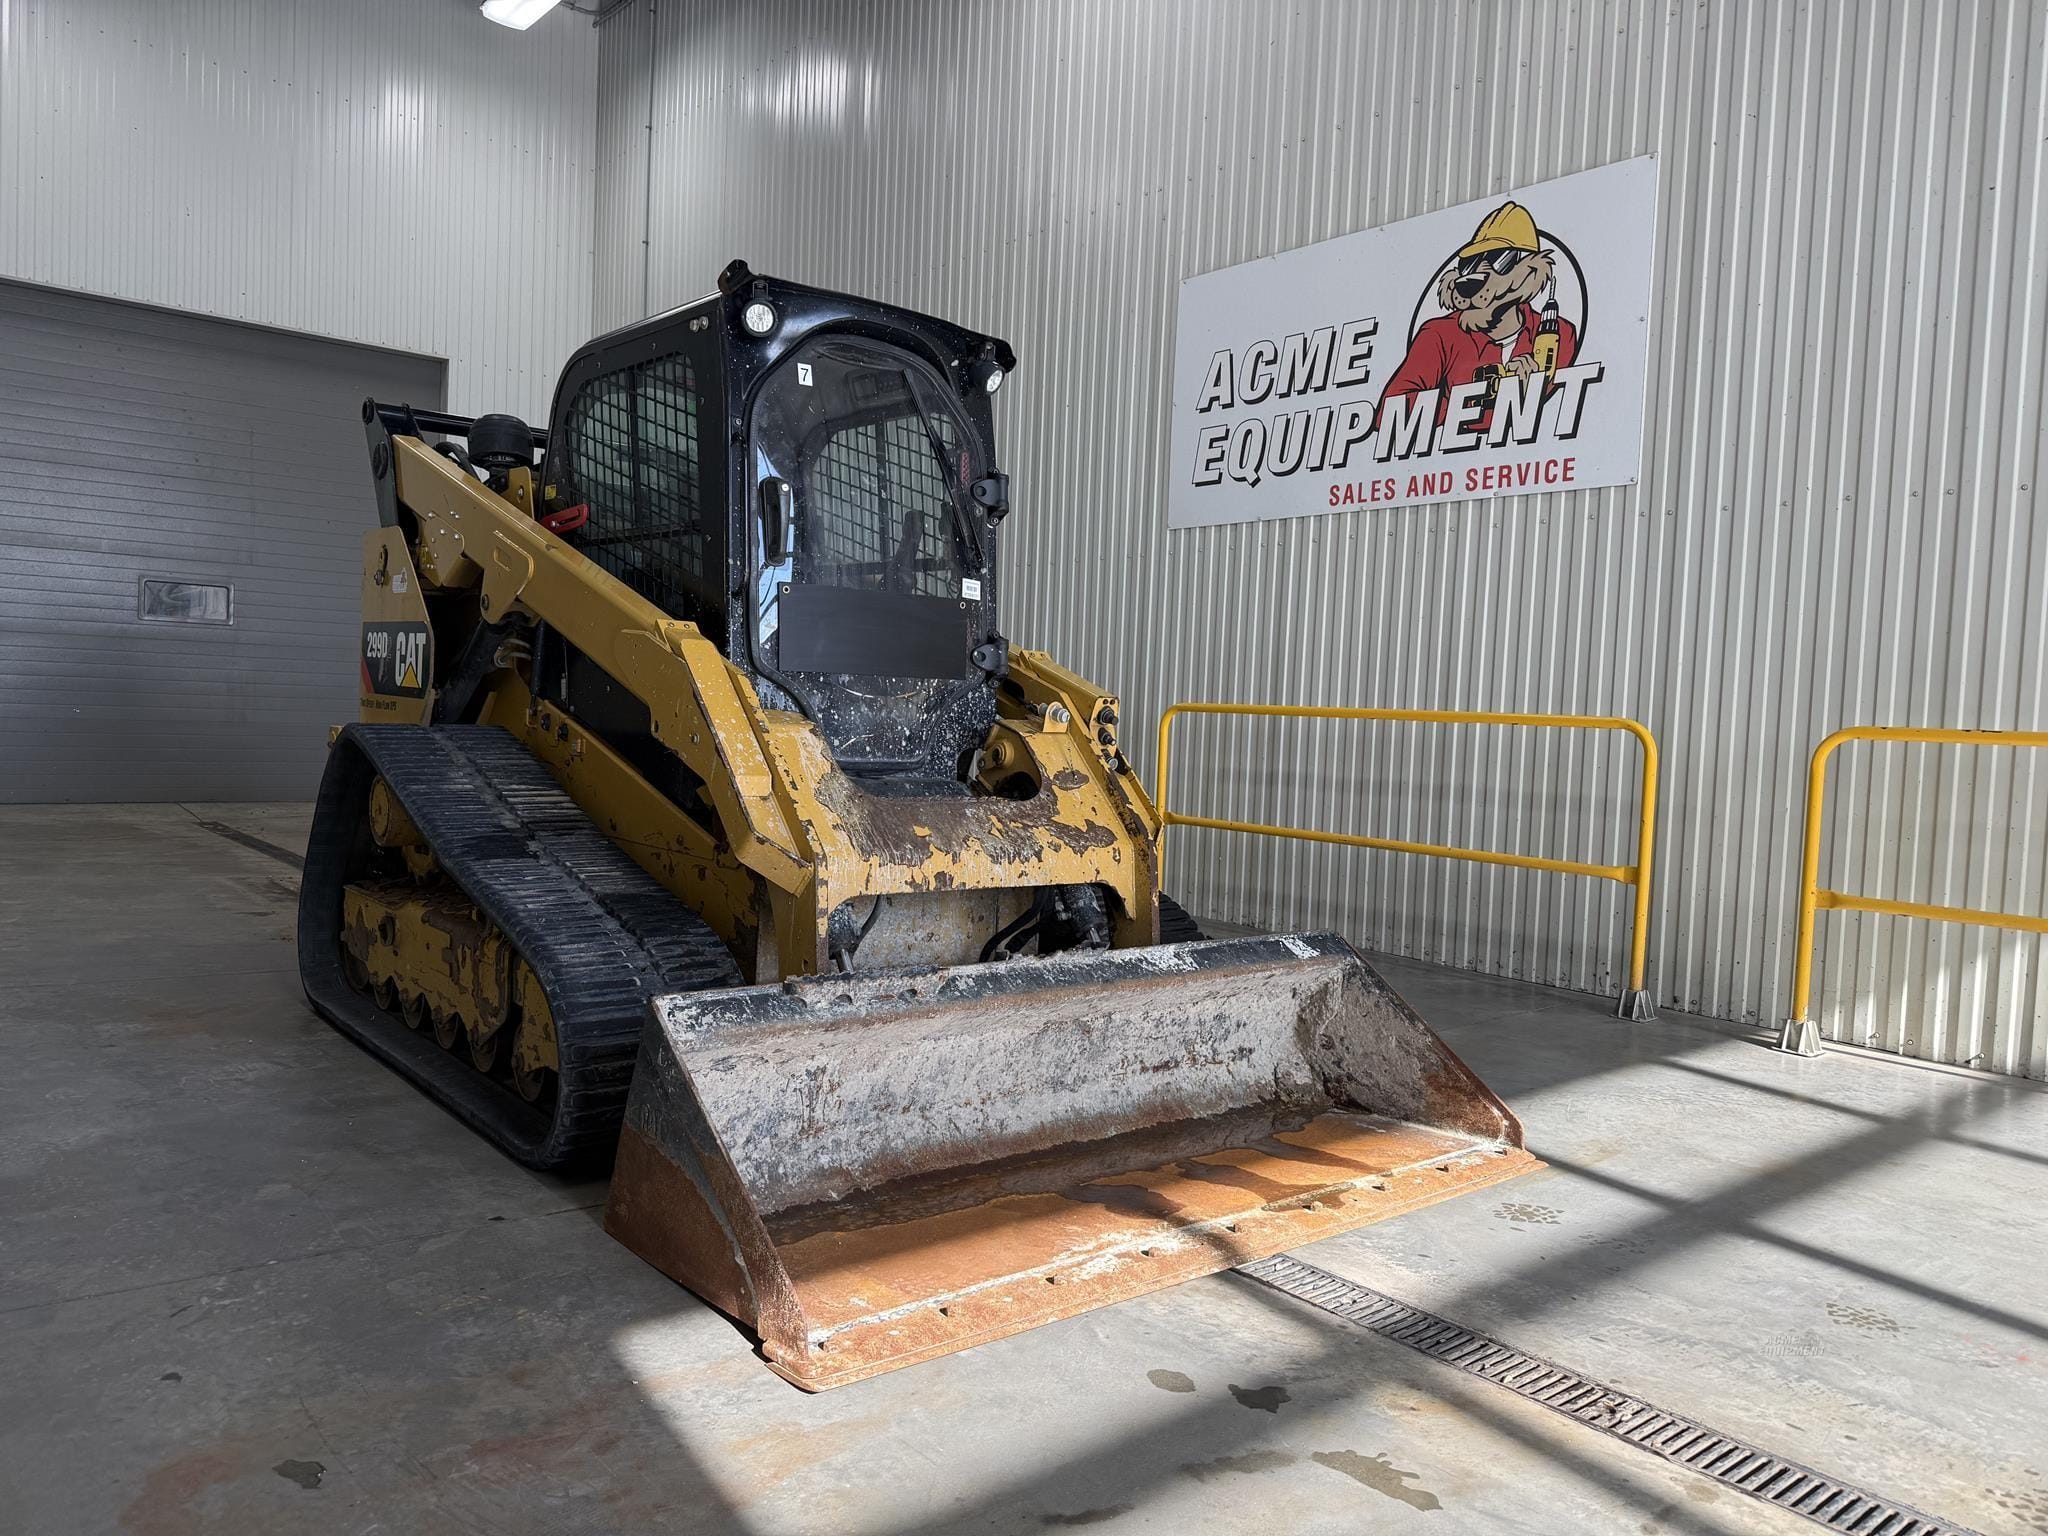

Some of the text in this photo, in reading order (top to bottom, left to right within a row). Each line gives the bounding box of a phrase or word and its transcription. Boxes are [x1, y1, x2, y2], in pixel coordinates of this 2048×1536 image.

[799, 367, 809, 382] 7
[1196, 317, 1378, 412] ACME
[1191, 361, 1604, 487] EQUIPMENT
[1328, 457, 1576, 507] SALES AND SERVICE
[395, 631, 427, 688] CAT
